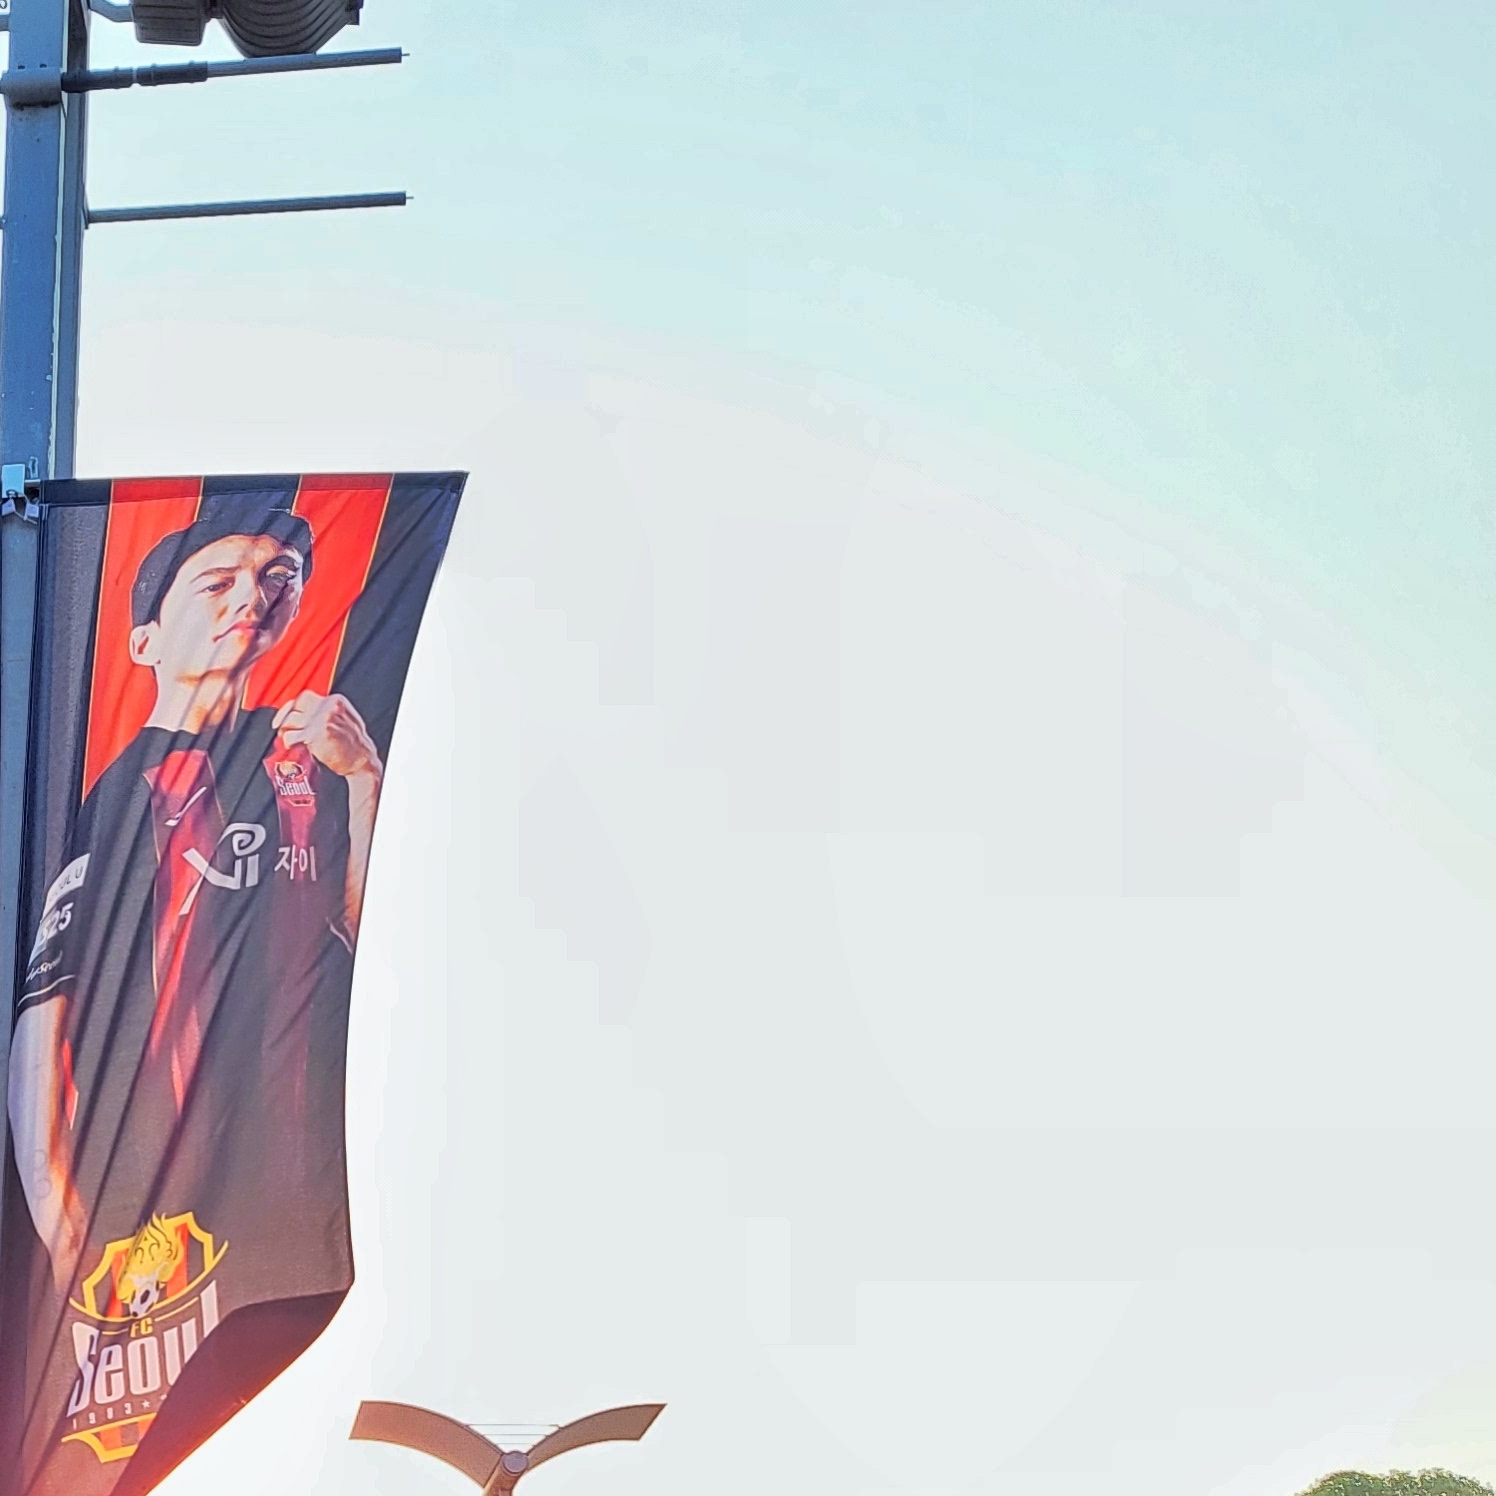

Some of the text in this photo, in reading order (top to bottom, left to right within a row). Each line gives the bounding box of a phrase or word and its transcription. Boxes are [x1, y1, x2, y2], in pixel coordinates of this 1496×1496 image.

[276, 776, 316, 796] Seoul
[274, 845, 316, 881] 자이
[131, 1317, 153, 1338] FC
[66, 1280, 219, 1418] Seoul
